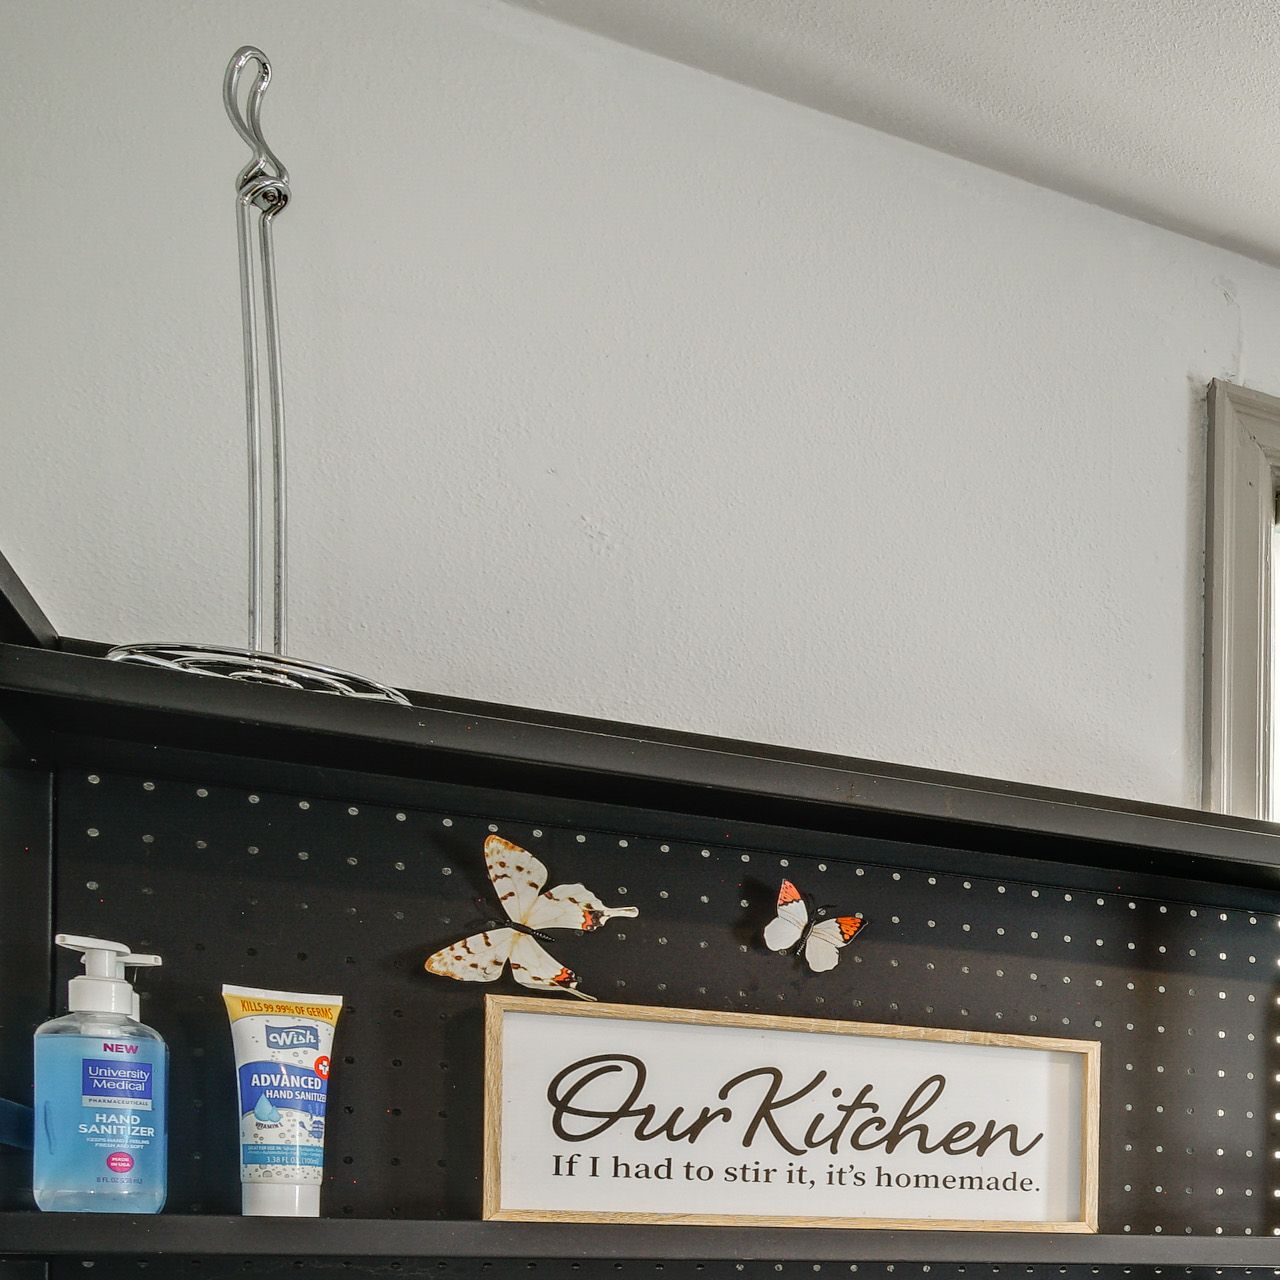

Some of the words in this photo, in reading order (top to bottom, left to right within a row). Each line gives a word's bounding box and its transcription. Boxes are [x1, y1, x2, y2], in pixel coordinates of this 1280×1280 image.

[240, 1000, 263, 1012] KILLS
[263, 1003, 295, 1015] 99.99%
[294, 1006, 304, 1015] OF
[306, 1007, 334, 1020] GERMS
[269, 1029, 316, 1046] Wish
[103, 1043, 139, 1054] NEW
[88, 1066, 150, 1081] University
[92, 1079, 145, 1091] Medical
[251, 1074, 322, 1090] ADVANCED
[265, 1089, 294, 1100] HAND
[547, 1053, 731, 1145] Our
[719, 1066, 1044, 1157] Kitchen
[95, 1113, 141, 1125] HAND
[78, 1123, 155, 1137] SANITIZER
[552, 1153, 582, 1178] If
[589, 1156, 600, 1179] I
[611, 1156, 673, 1182] had
[683, 1162, 715, 1182] to
[723, 1160, 778, 1185] stir
[786, 1162, 816, 1189] it,
[826, 1163, 867, 1187] it's
[875, 1166, 1042, 1192] homemade.
